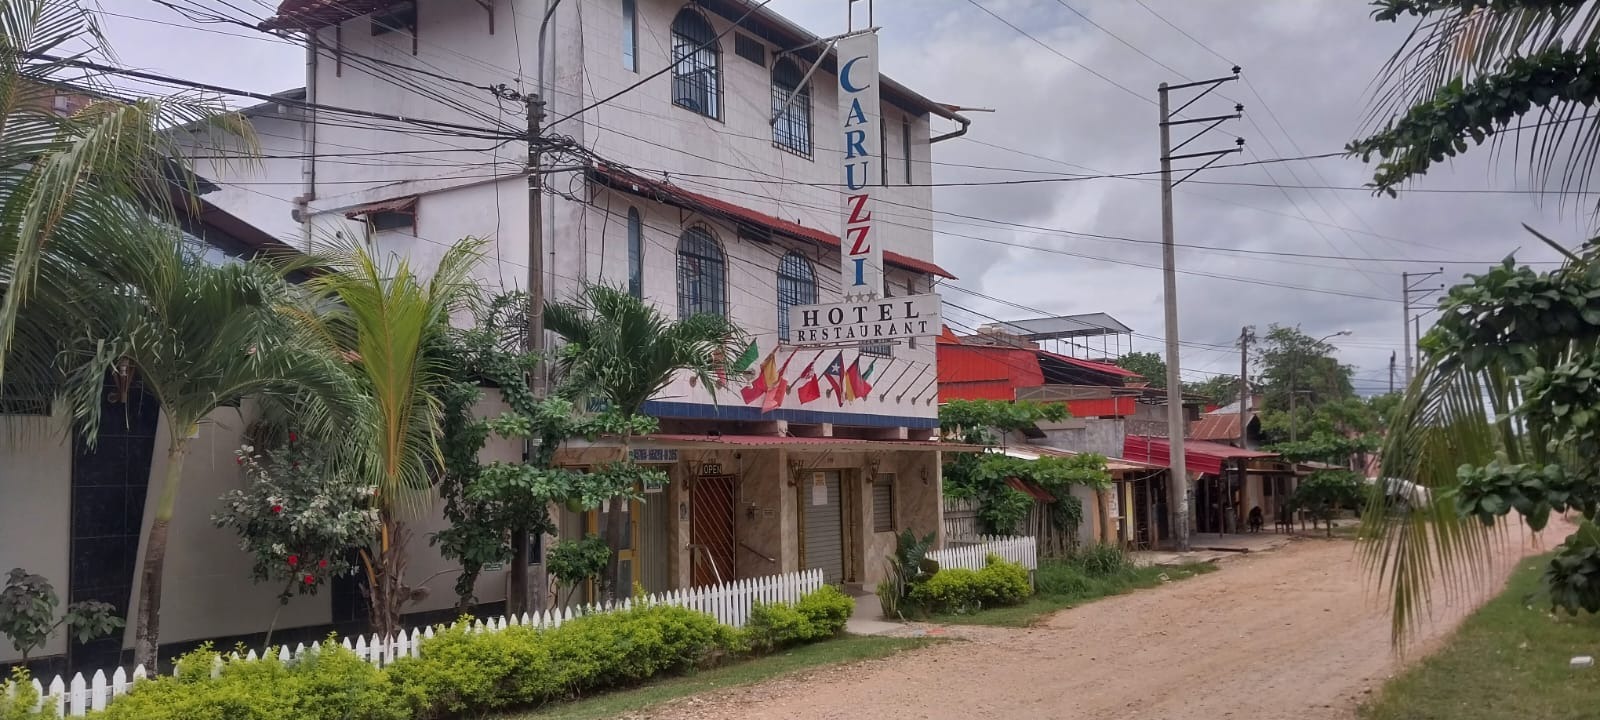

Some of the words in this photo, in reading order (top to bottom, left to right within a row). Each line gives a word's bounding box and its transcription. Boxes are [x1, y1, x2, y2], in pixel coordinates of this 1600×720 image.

[840, 55, 871, 287] CARUZZI
[802, 301, 920, 327] HOTEL
[799, 321, 928, 341] RESTAURANT
[703, 464, 722, 474] OPEN
